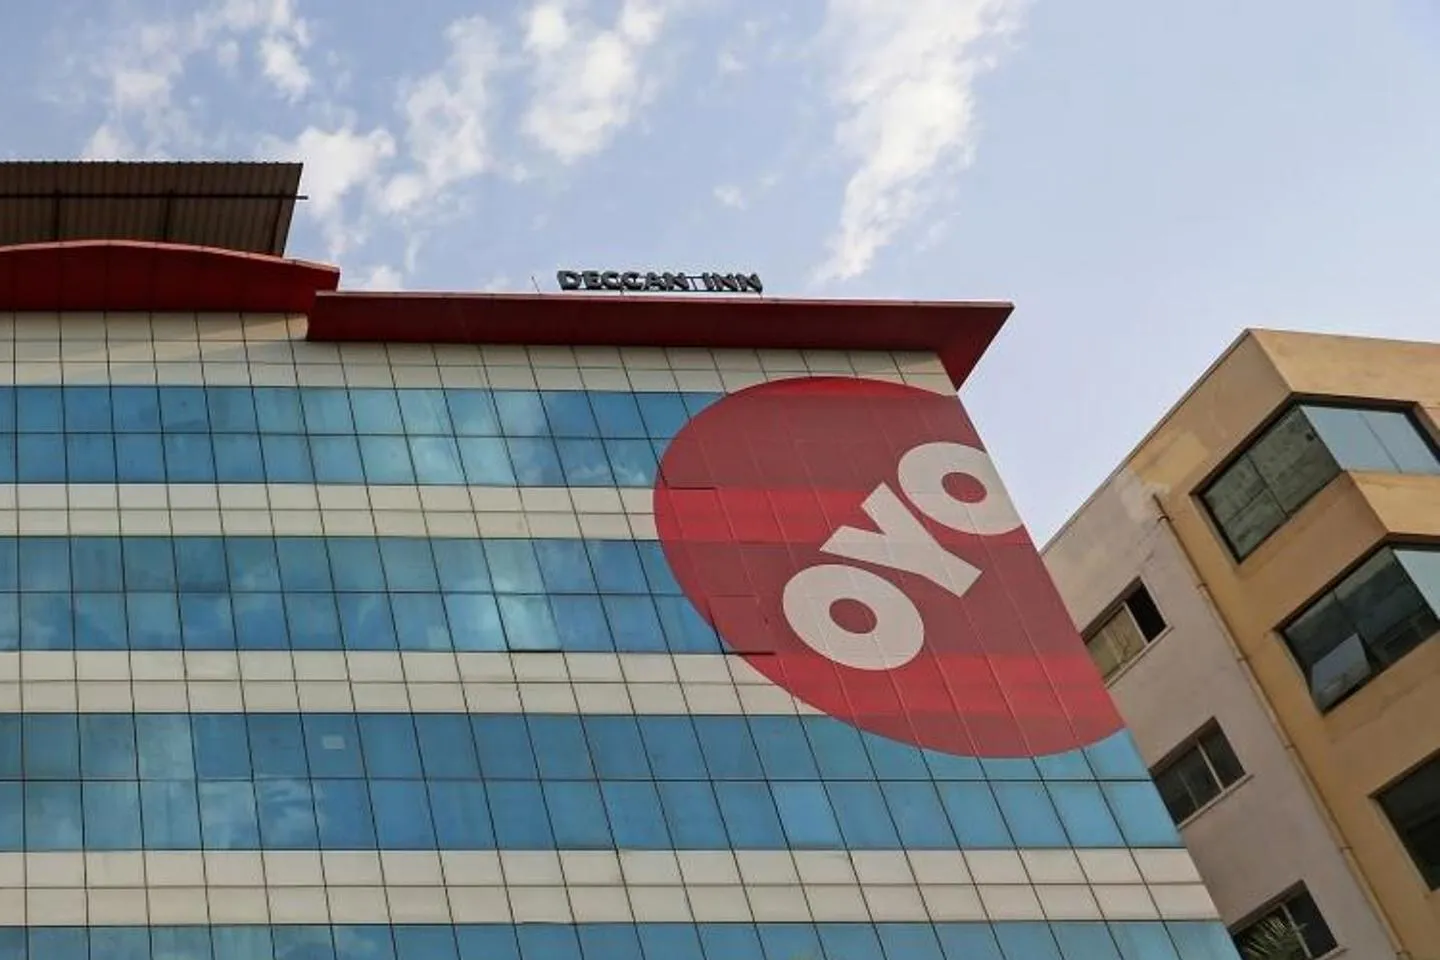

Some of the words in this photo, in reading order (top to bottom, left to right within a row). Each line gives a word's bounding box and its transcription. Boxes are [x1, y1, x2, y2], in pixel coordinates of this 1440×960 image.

[557, 270, 689, 292] DECCAN
[701, 272, 763, 293] INN
[782, 441, 1025, 671] OYO
